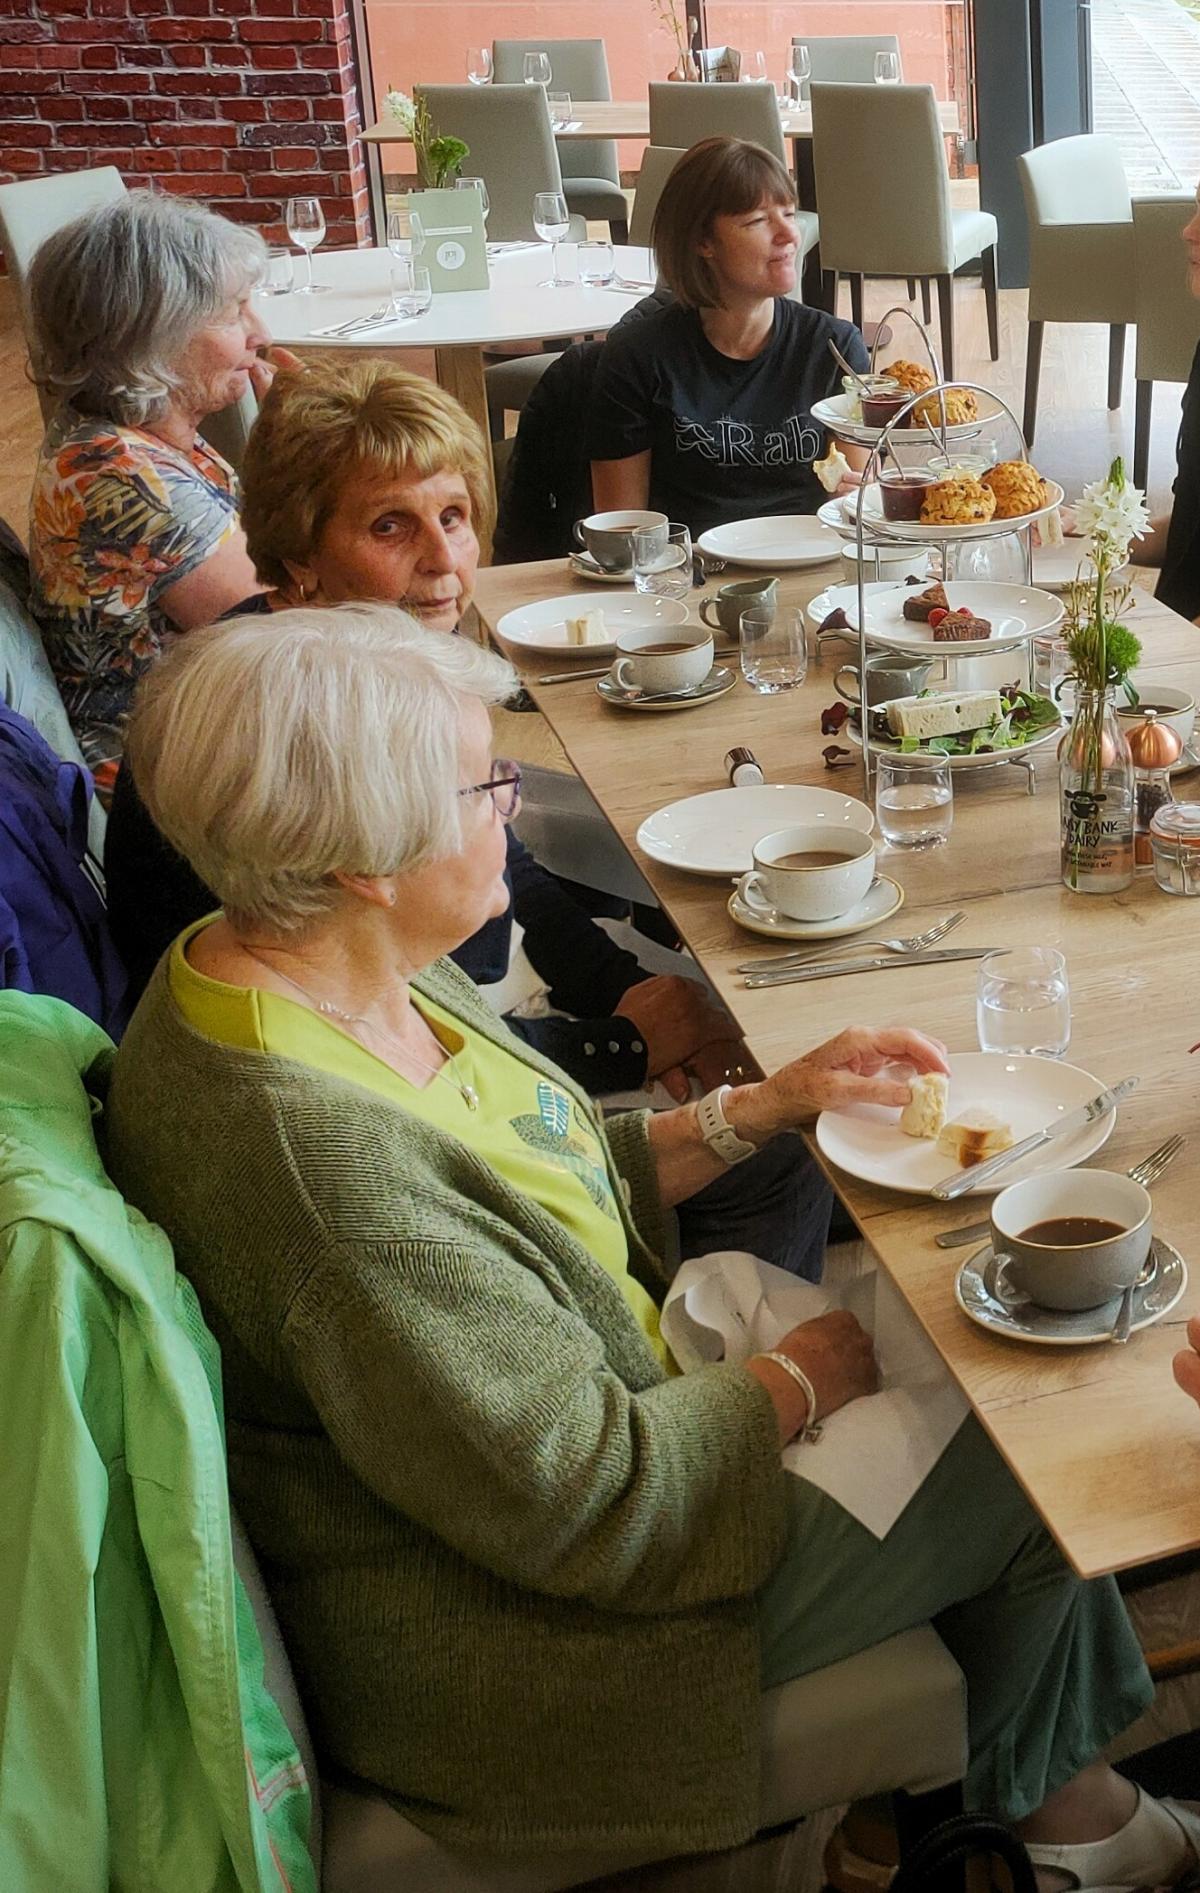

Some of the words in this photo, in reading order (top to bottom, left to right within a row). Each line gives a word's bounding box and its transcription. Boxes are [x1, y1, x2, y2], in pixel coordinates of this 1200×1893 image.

[715, 415, 820, 468] Rab
[1084, 820, 1118, 834] BANK
[1069, 834, 1100, 848] DAIRY
